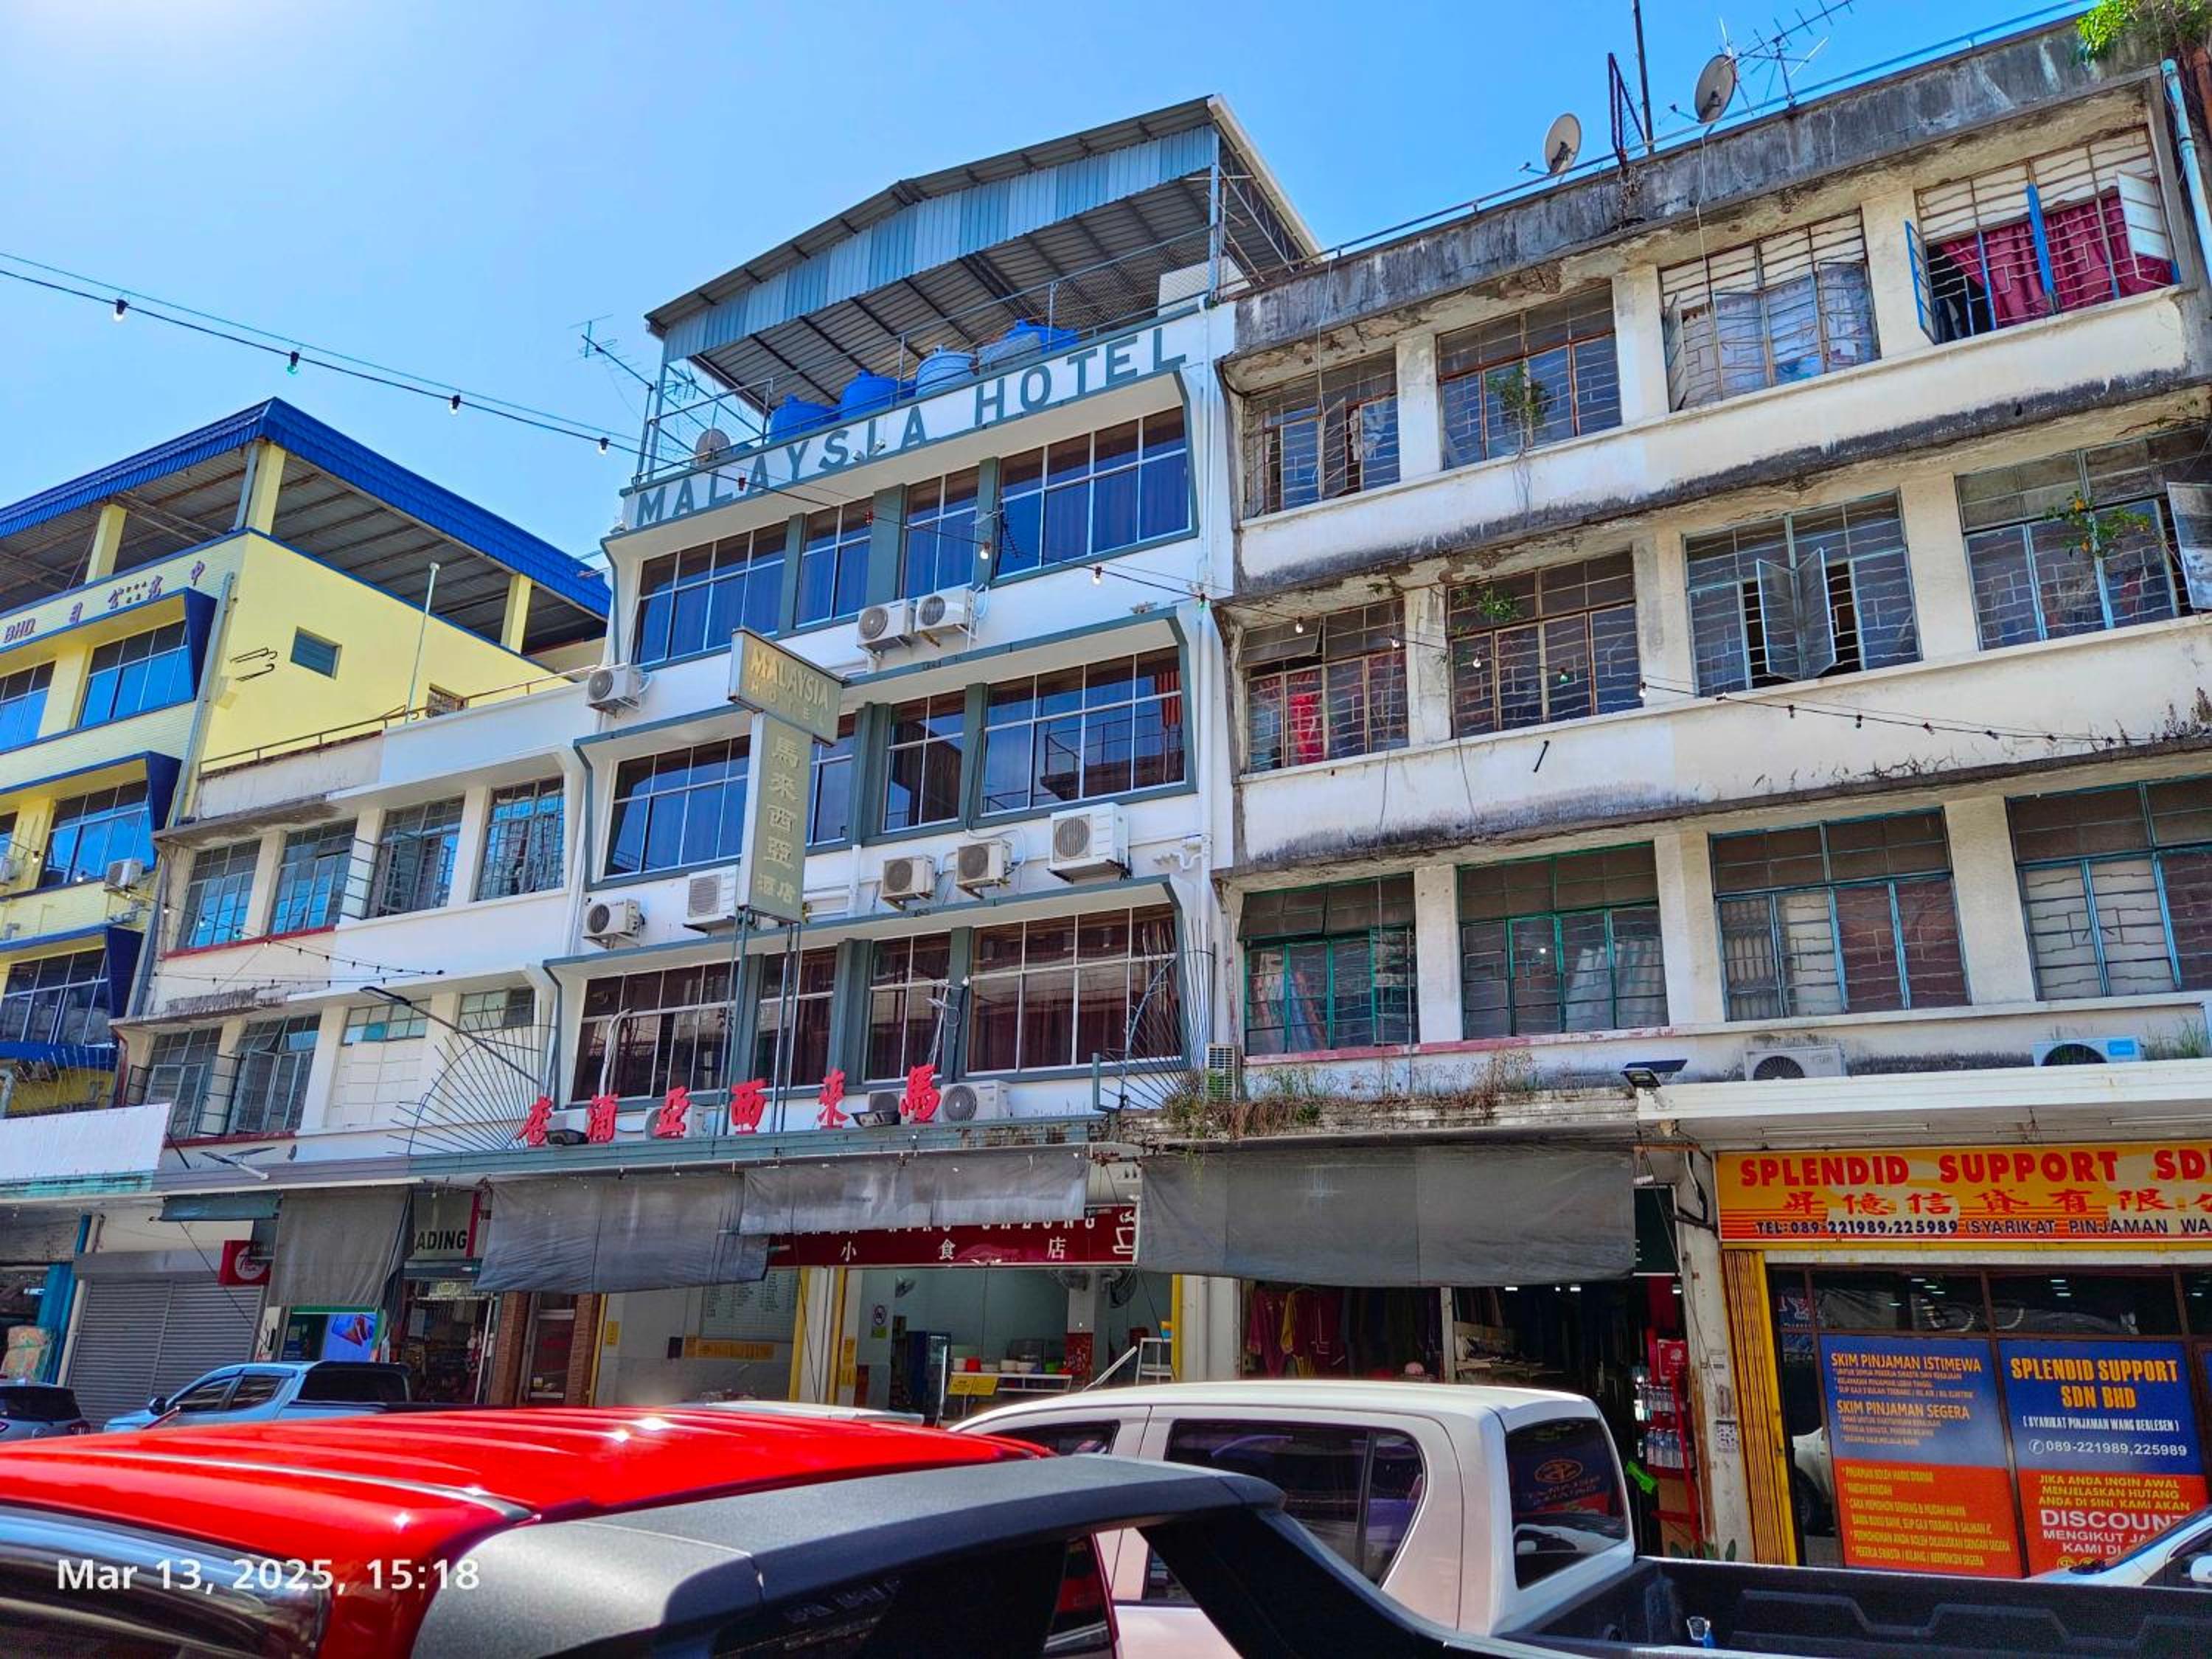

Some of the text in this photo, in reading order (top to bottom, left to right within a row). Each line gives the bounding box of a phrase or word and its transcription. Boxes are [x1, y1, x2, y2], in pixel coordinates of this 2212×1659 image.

[637, 327, 1186, 526] MALAYSIA HOTEL
[750, 644, 829, 711] MALAYSIA
[1740, 1149, 2212, 1186] SPLENDID SUPPORT SD
[2069, 1219, 2168, 1234] PINJAMAN
[1831, 1353, 1983, 1372] SKIM PINJAMAN ISTIMEWA
[2011, 1357, 2178, 1382] SPLENDID SUPPORT
[2061, 1385, 2137, 1408] SDN BHD
[1837, 1400, 1971, 1419] SKIM PINJAMAN SEGERA
[2046, 1439, 2188, 1456] 089-221989,225989
[2039, 1475, 2180, 1489] JIKA ANDA INGIN AWAL
[2042, 1486, 2180, 1500] MENJELASKAN HUTANG
[2039, 1496, 2073, 1506] ANDA
[2075, 1497, 2087, 1507] DI
[2119, 1499, 2151, 1510] KAMI
[2154, 1500, 2191, 1511] AKAN
[2042, 1529, 2124, 1543] MENGIKUT
[2062, 1543, 2101, 1554] KAMI
